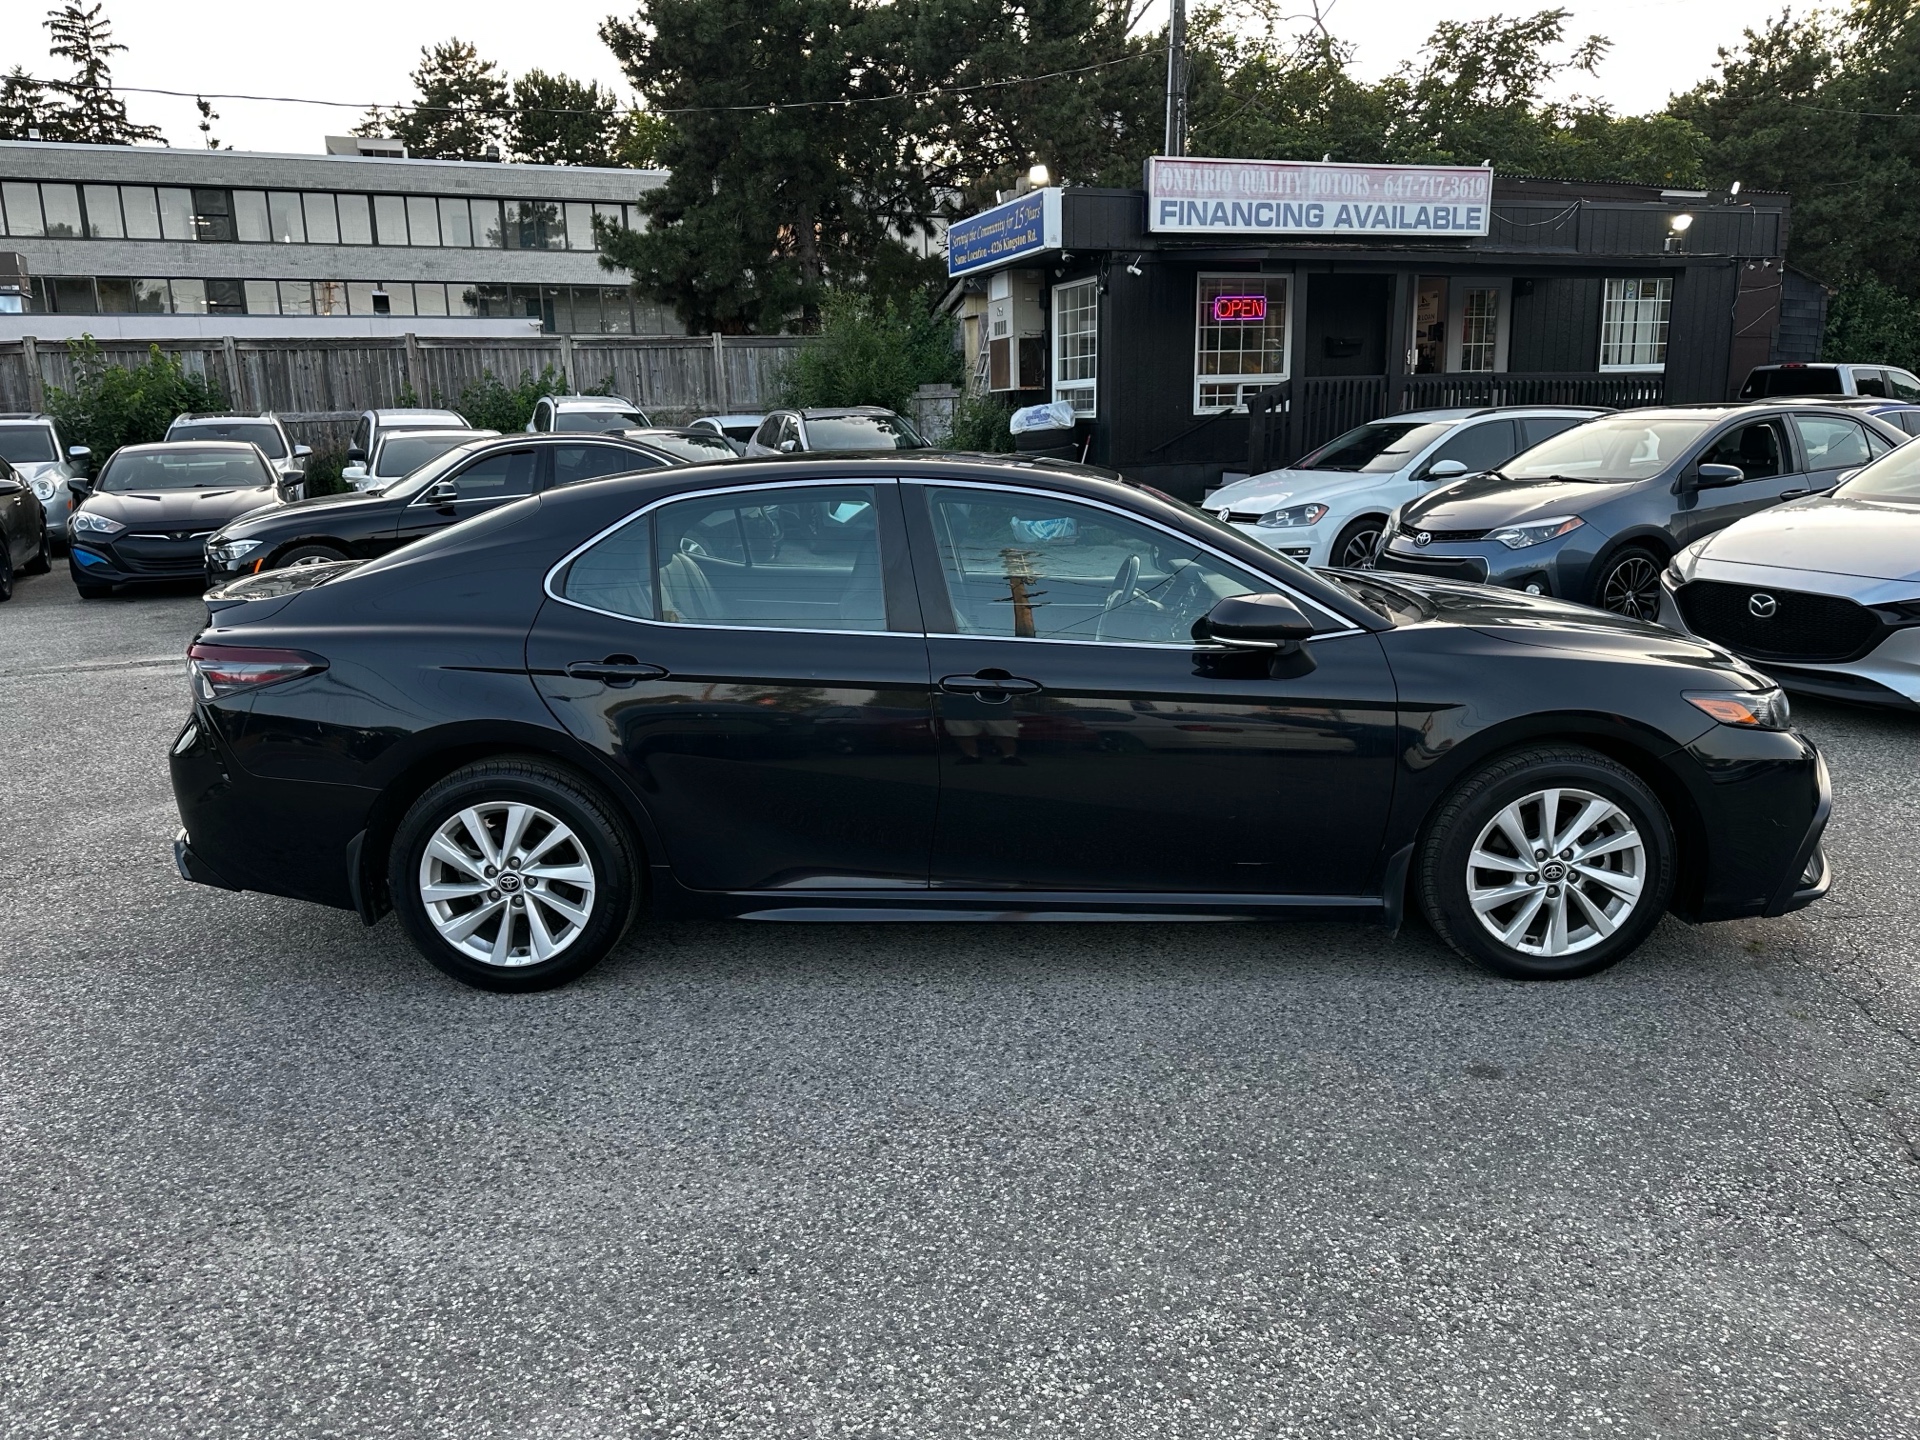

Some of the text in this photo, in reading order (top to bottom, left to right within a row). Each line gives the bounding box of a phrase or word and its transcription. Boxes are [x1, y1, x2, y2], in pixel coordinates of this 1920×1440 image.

[1161, 167, 1486, 199] ONTARIO QUALITY MOTORS 647-717-3619
[977, 219, 1005, 239] Community
[1005, 213, 1014, 236] for
[1013, 204, 1026, 230] 15
[1159, 200, 1482, 230] FINANCING AVAILABLE
[955, 254, 967, 266] Same
[967, 246, 987, 262] Location
[991, 240, 1003, 254] 4226
[1003, 235, 1026, 252] Kingston
[1027, 228, 1038, 243] Rd.
[1216, 299, 1264, 317] OPEN
